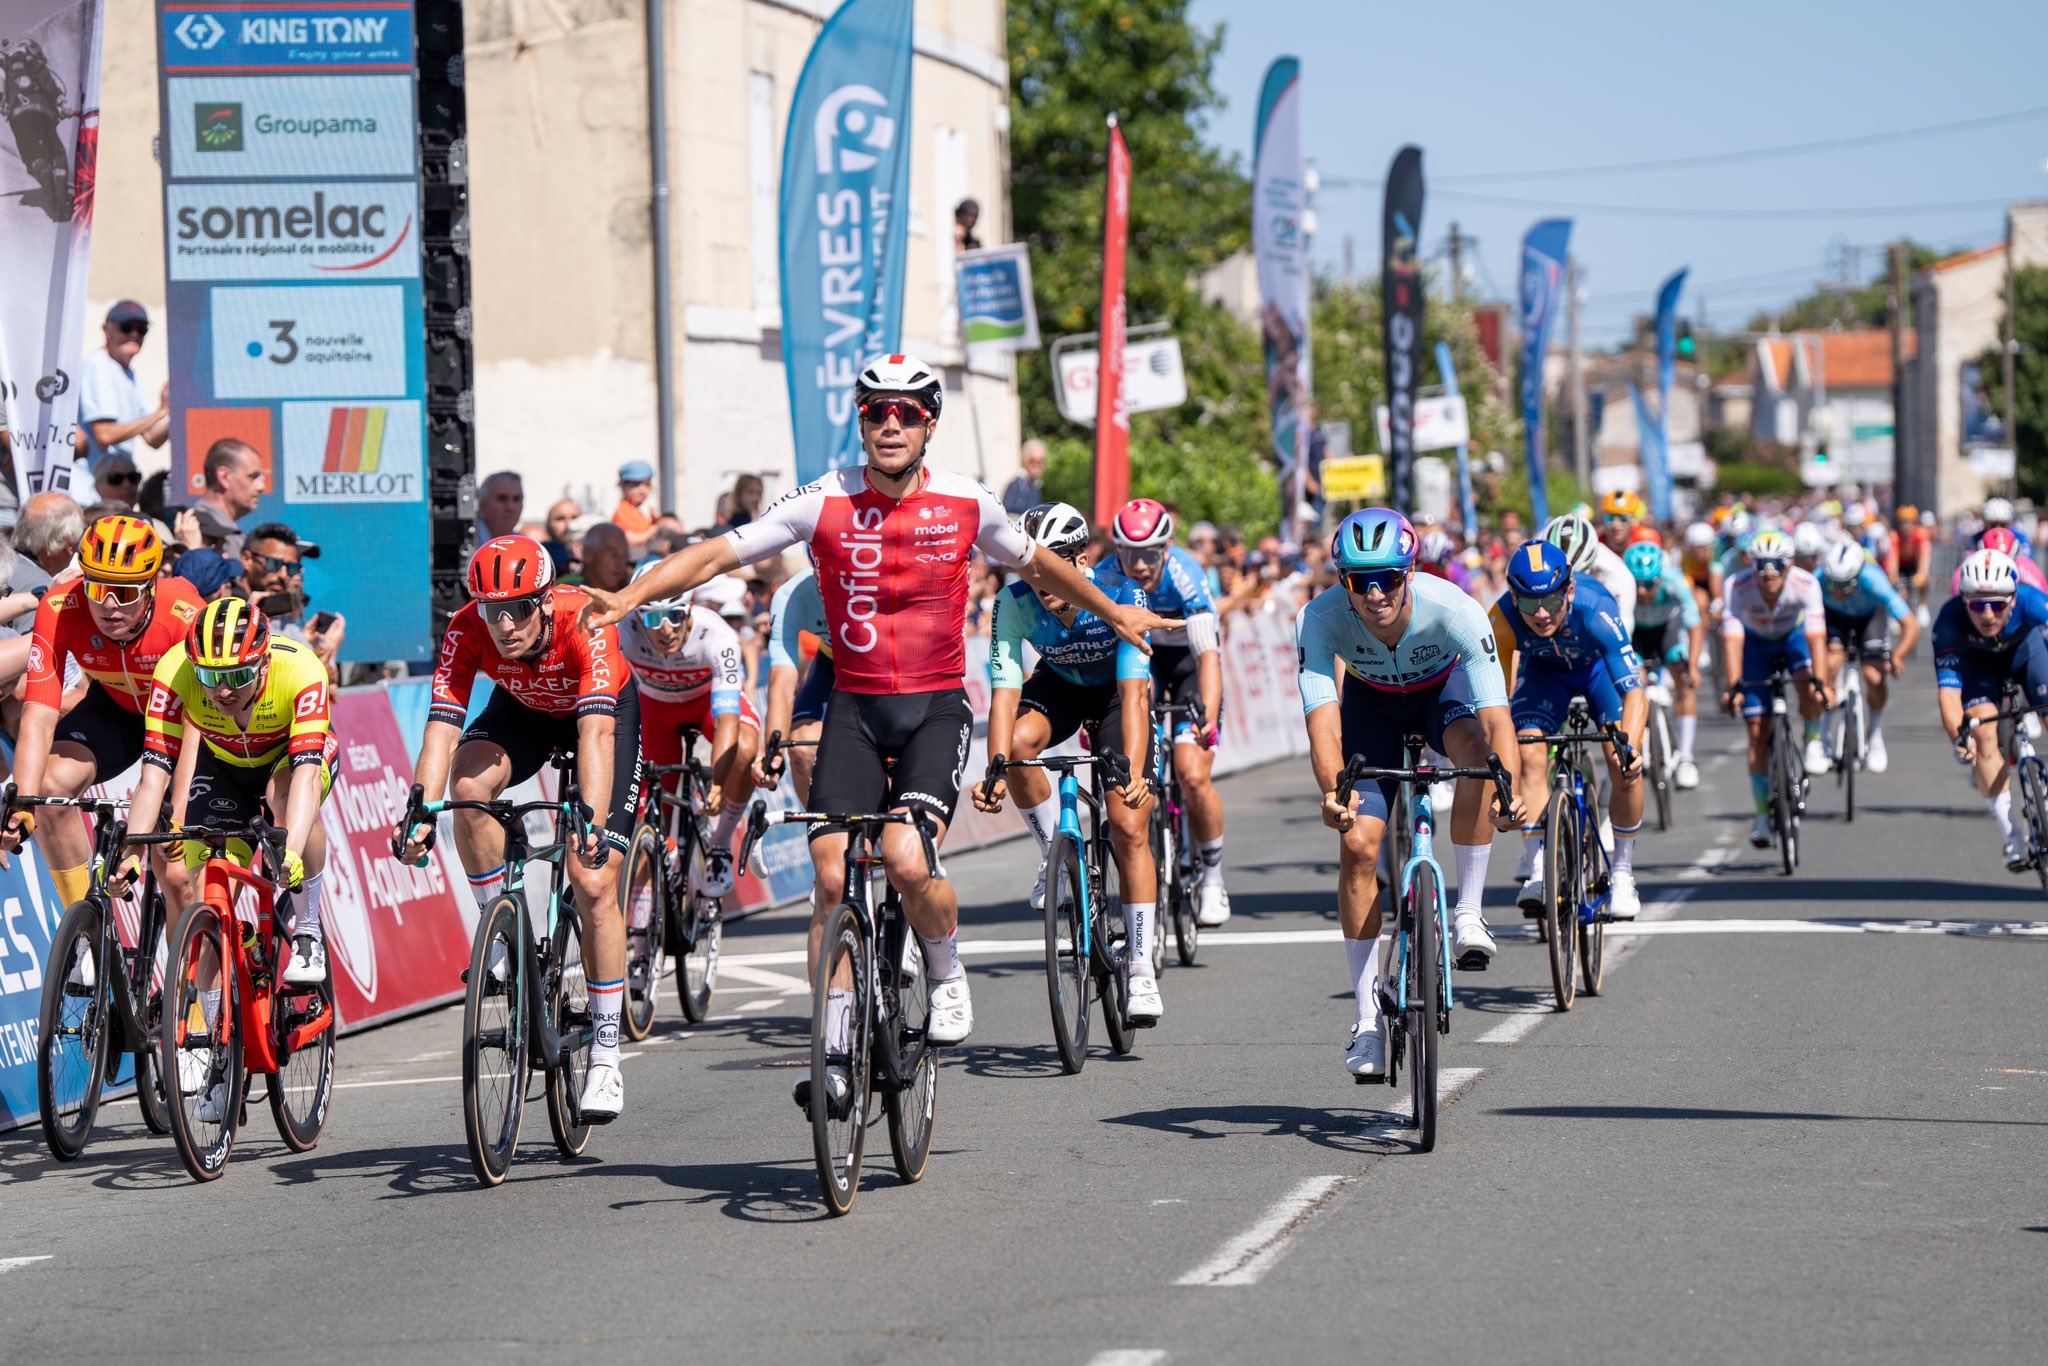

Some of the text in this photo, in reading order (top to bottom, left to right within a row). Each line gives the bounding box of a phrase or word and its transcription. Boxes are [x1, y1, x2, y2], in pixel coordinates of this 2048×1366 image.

[241, 17, 389, 44] KING TONY
[254, 113, 377, 138] Groupama
[177, 190, 386, 240] somelac
[268, 320, 299, 365] 3
[305, 333, 364, 346] nouvelle
[305, 350, 373, 364] aquitaine
[296, 472, 414, 495] MERLOT
[914, 521, 959, 535] mobel
[914, 537, 958, 547] LOOK
[840, 506, 883, 653] Cofidis
[991, 599, 1001, 658] DECATHLON
[432, 630, 464, 699] ARKEA
[587, 627, 611, 692] ARKEA
[494, 677, 580, 692] ARKEA
[623, 782, 640, 814] B&B
[900, 791, 949, 815] CORIMA
[603, 828, 631, 848] anch
